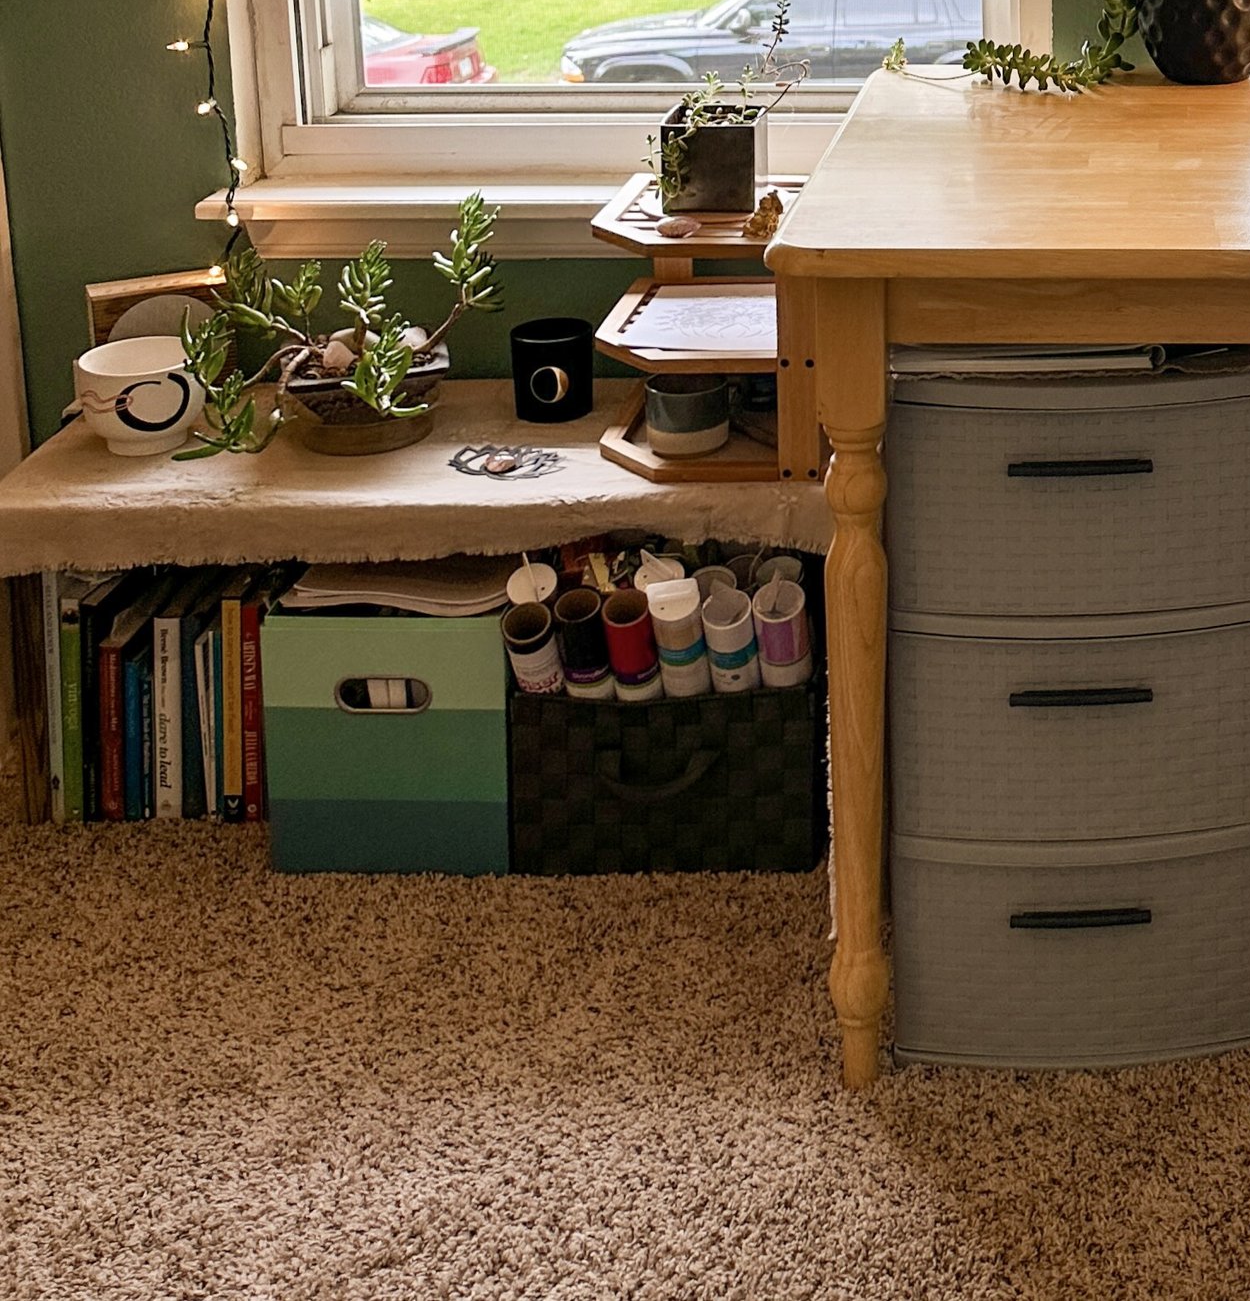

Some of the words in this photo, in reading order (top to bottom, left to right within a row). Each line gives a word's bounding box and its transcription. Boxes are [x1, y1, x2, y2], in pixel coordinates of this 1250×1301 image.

[160, 655, 169, 684] Brown
[159, 713, 171, 744] dare
[159, 746, 169, 759] to
[160, 760, 172, 789] lead
